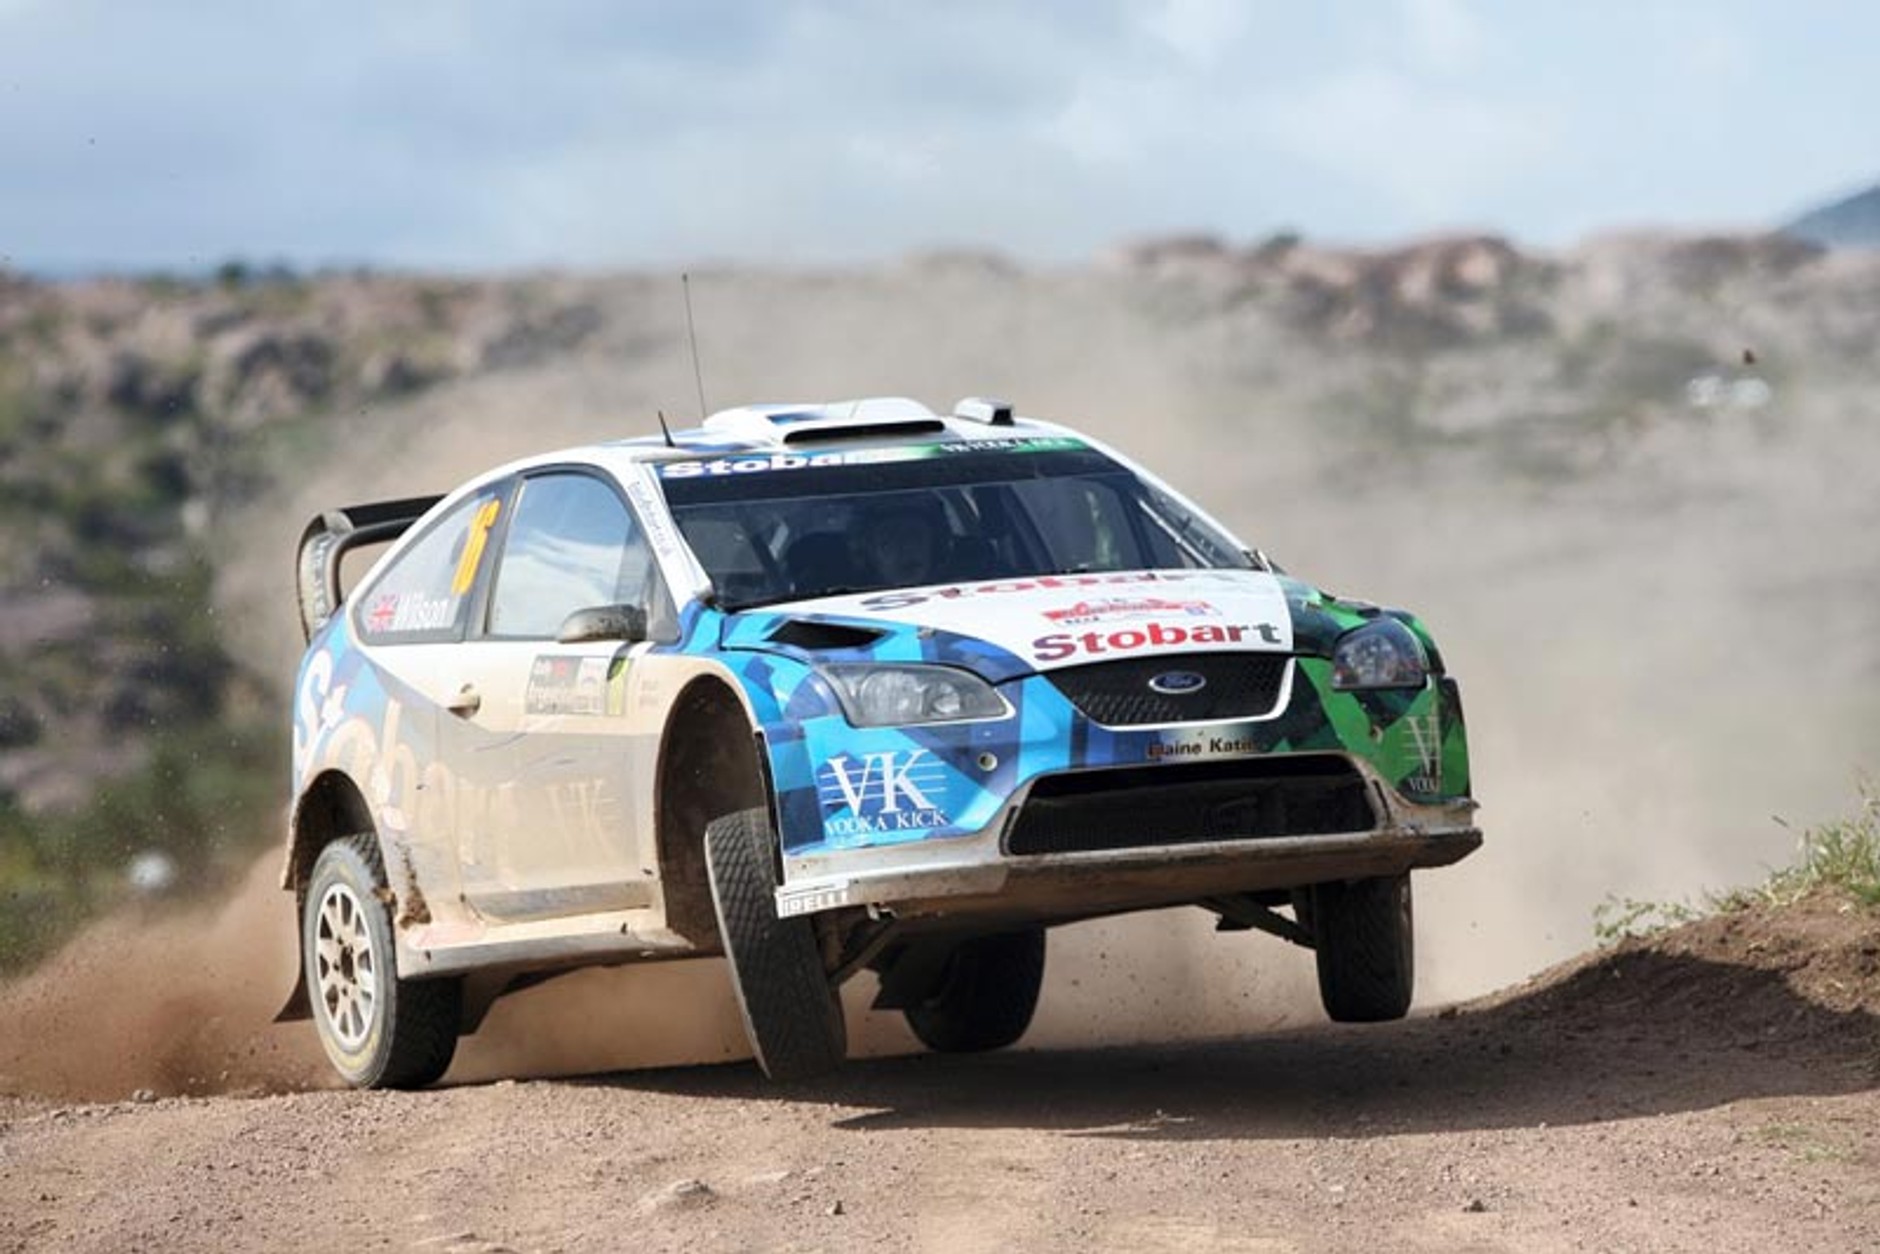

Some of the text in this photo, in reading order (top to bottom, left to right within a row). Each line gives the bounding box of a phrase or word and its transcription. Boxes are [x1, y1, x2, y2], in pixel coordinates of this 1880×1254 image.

[1033, 622, 1282, 662] Stobart
[826, 749, 938, 817] VK
[825, 810, 948, 836] VODKA KICK
